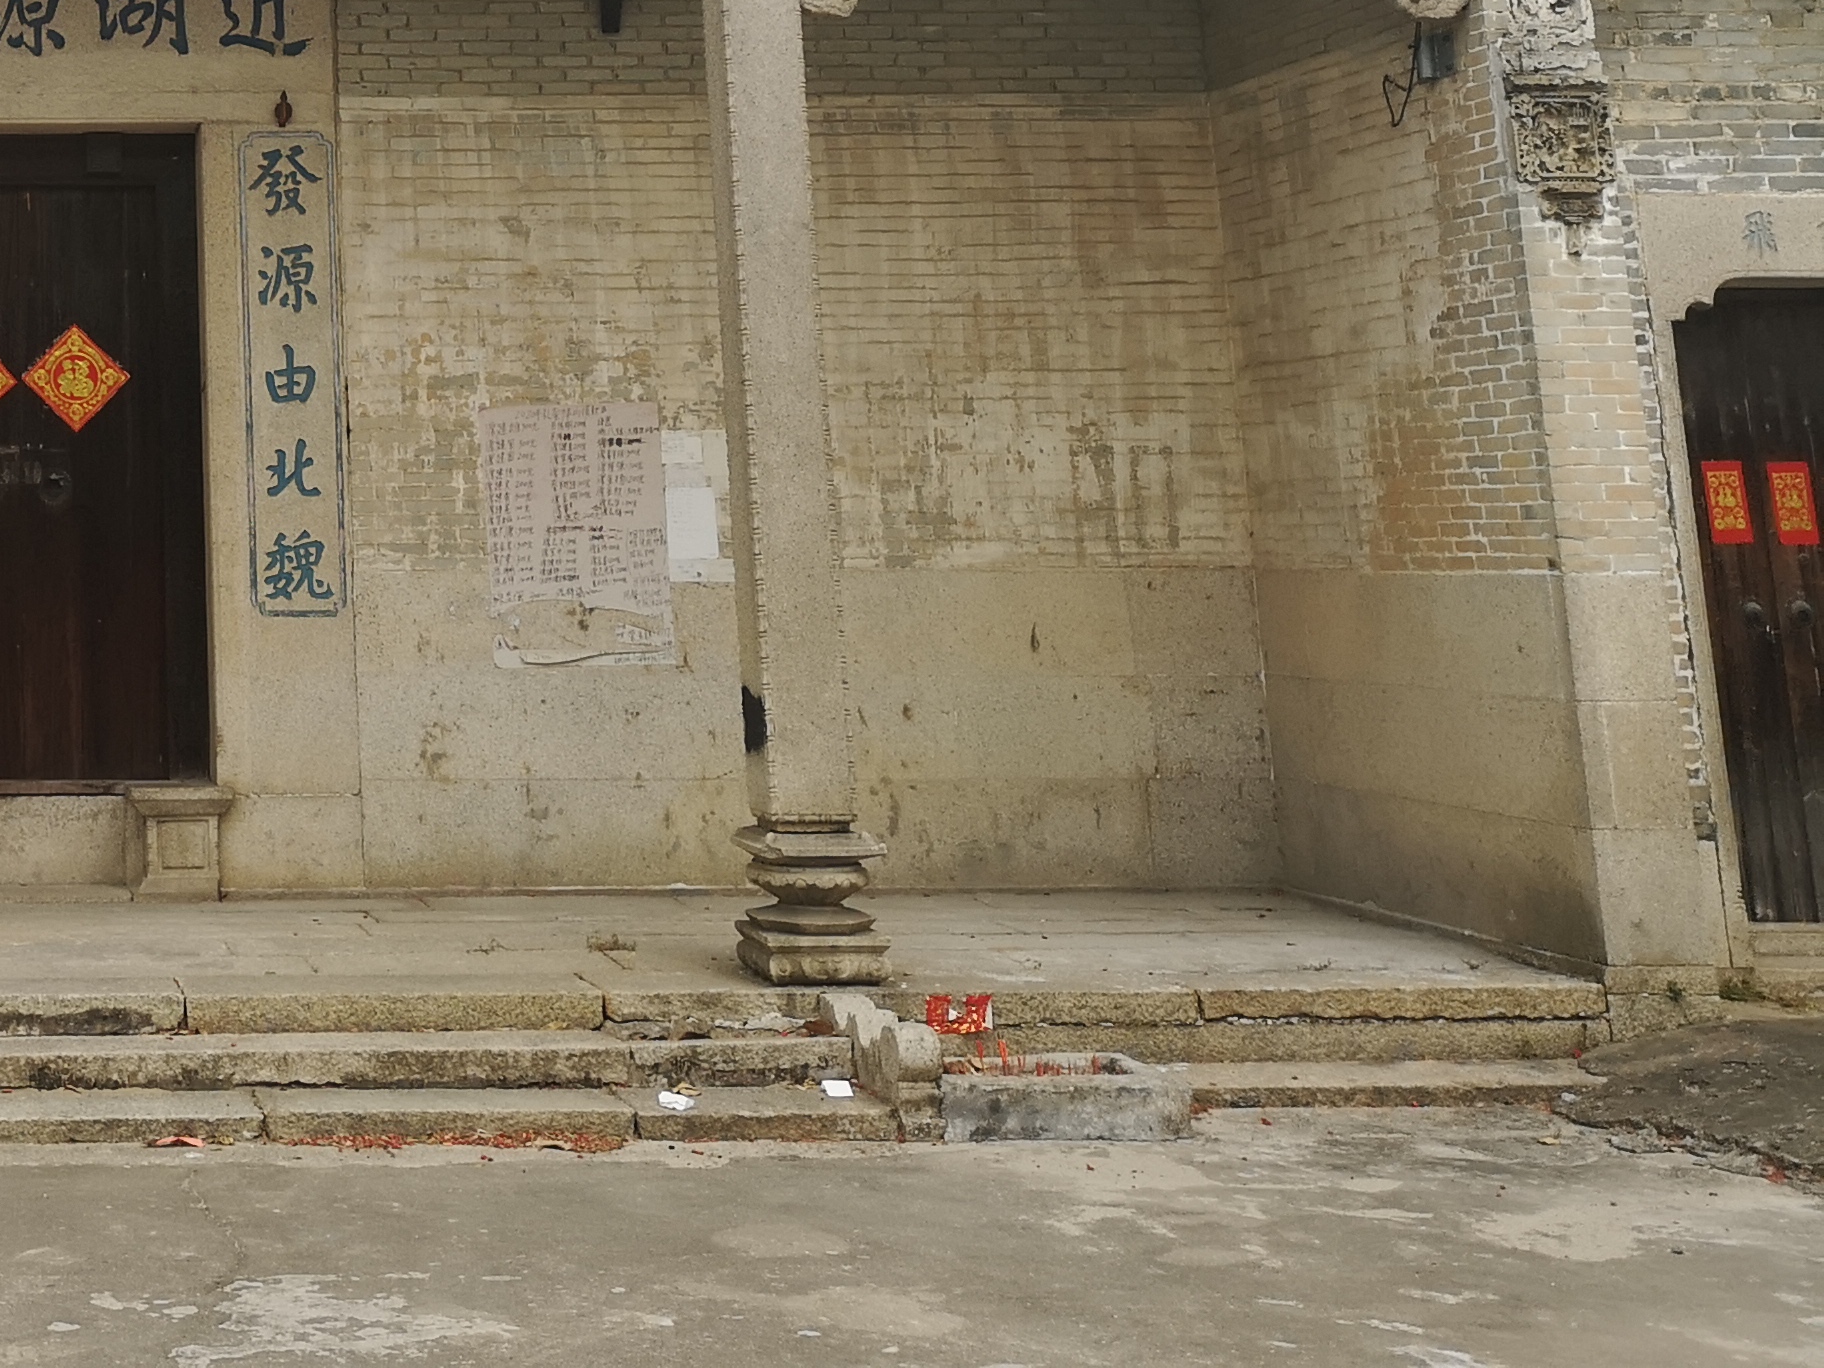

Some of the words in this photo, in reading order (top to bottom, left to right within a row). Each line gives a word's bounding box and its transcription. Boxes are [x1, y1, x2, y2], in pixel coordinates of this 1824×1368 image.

[58, 359, 94, 398] 福
[248, 144, 334, 602] 發源由北魏
